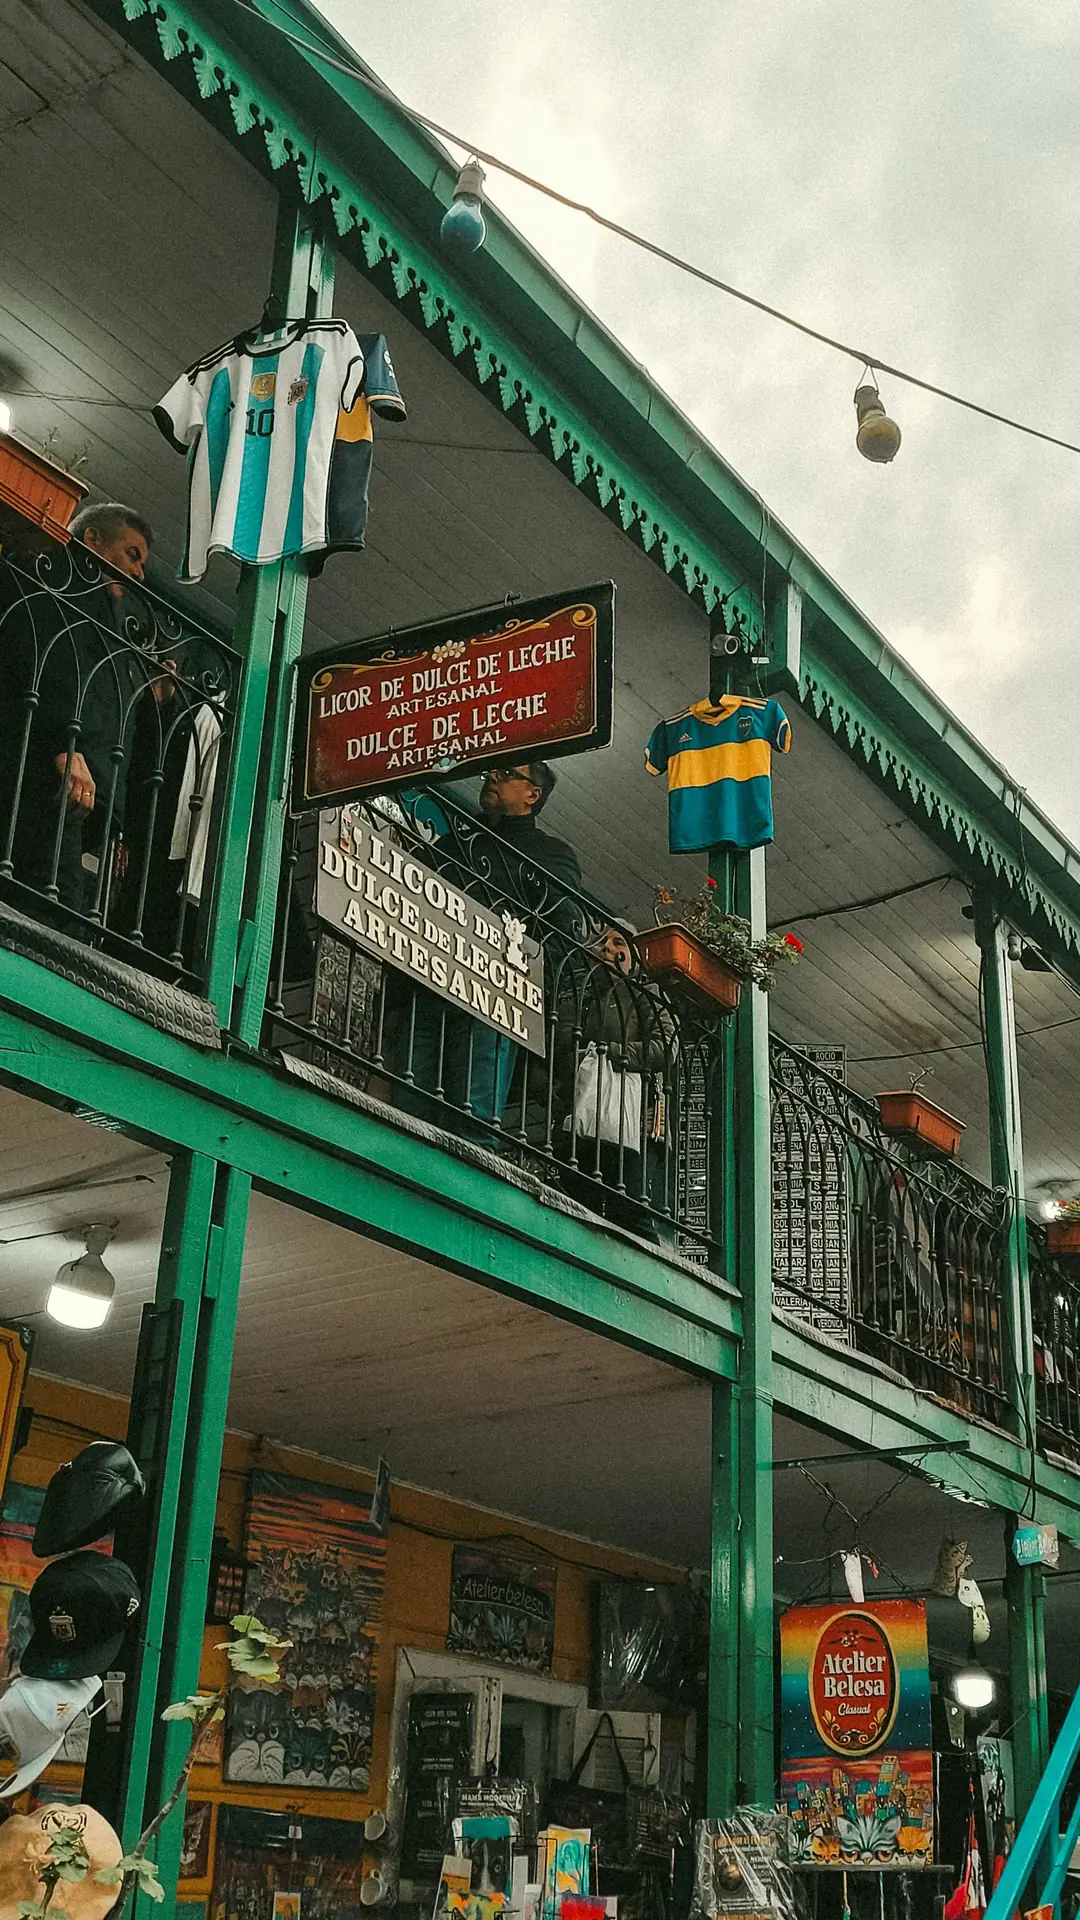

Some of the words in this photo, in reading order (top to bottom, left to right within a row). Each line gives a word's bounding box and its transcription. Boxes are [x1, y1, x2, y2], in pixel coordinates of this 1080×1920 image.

[246, 408, 275, 437] 10
[319, 688, 373, 719] LICOR
[380, 675, 405, 703] DE
[411, 659, 472, 693] DULCE
[475, 651, 503, 679] DE
[507, 634, 576, 673] LECHE
[385, 679, 503, 720] ARTESANAL
[346, 722, 418, 761] DULCE
[431, 712, 460, 741] DE
[471, 692, 548, 729] LECHE
[386, 729, 507, 770] ARTESANAL
[369, 834, 468, 927] LICOR
[474, 914, 501, 950] DE
[321, 840, 420, 933] DULCE
[423, 918, 451, 954] DE
[453, 931, 544, 1015] LECHE
[343, 898, 528, 1041] ARTESANAL
[815, 1051, 836, 1061] ROCIO
[775, 1296, 808, 1307] VALERIA
[463, 1577, 505, 1602] Atelier
[821, 1650, 886, 1675] Atelier
[824, 1674, 886, 1698] Belesa
